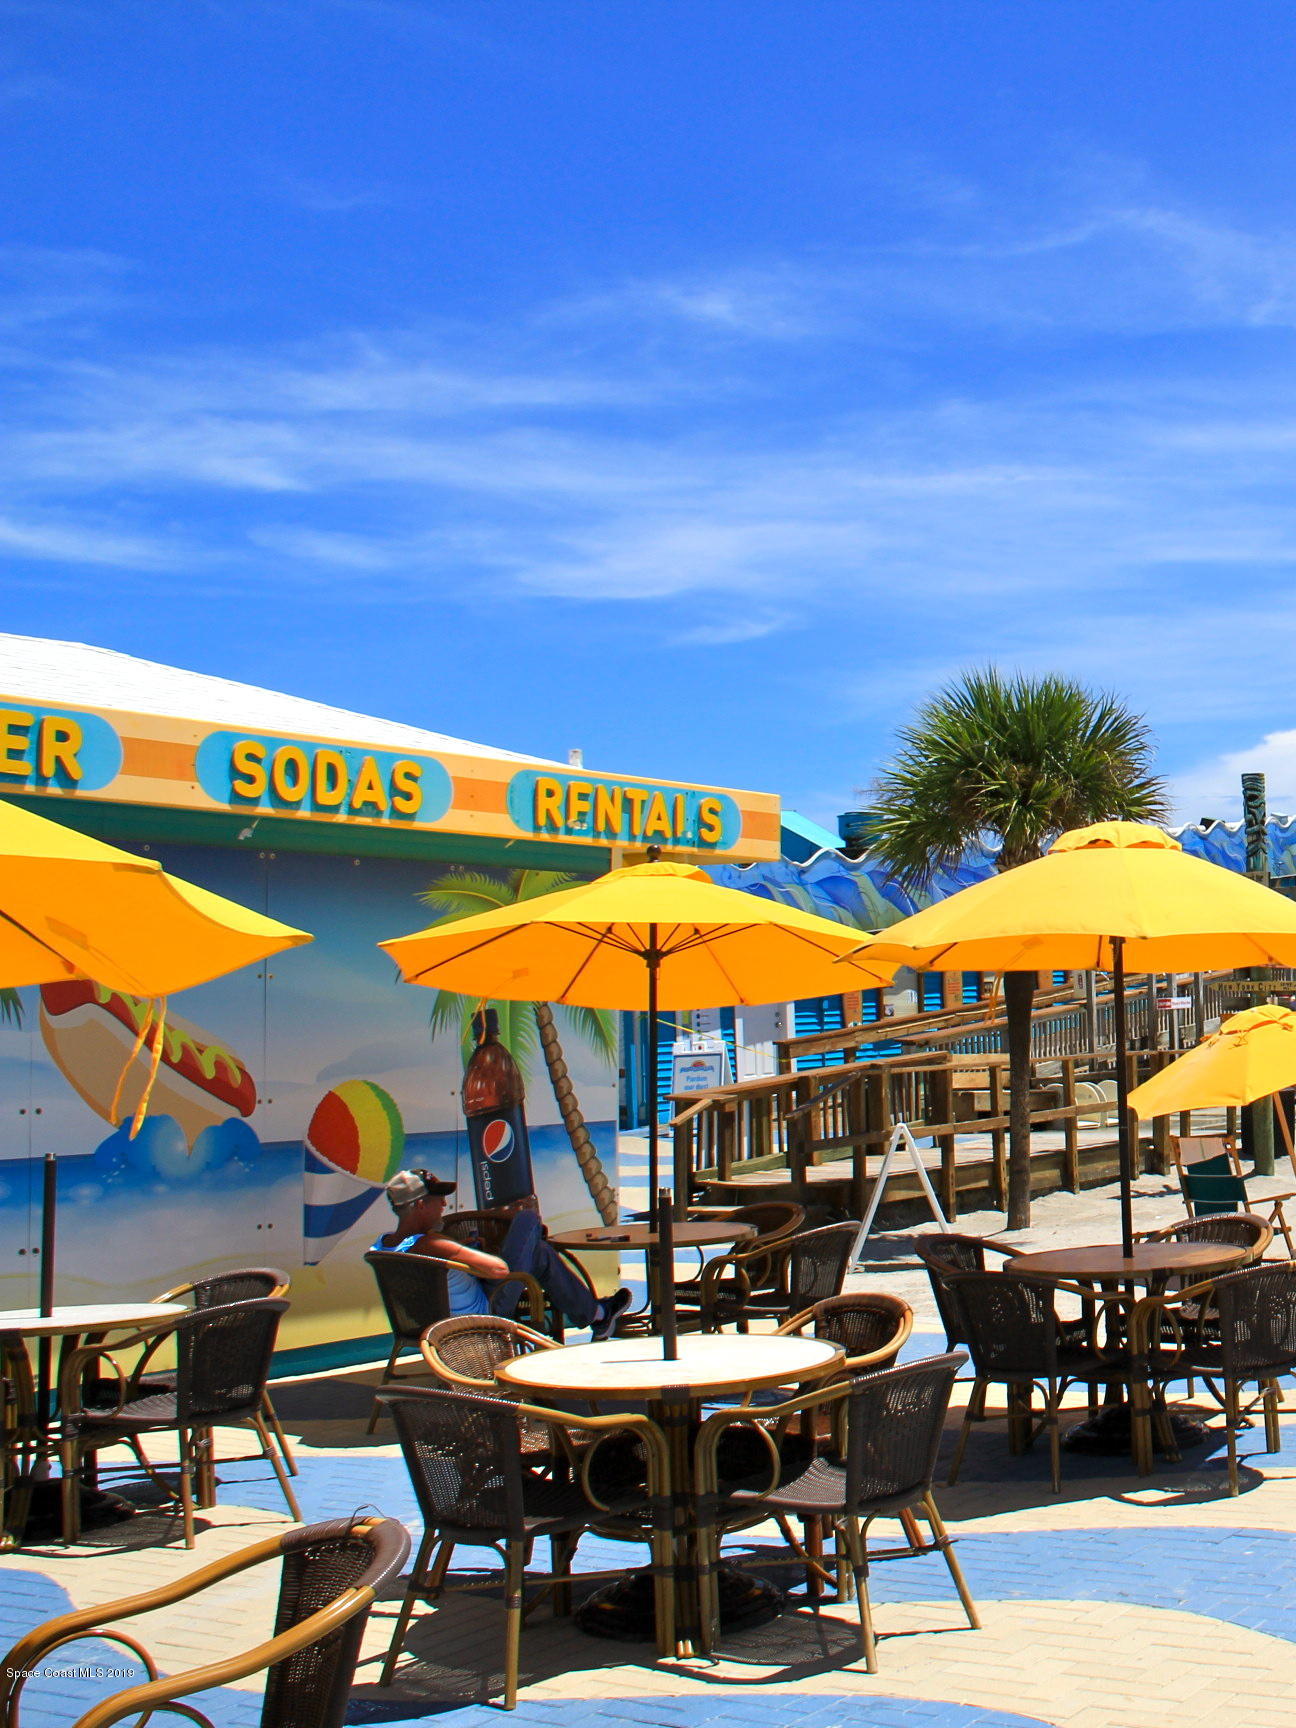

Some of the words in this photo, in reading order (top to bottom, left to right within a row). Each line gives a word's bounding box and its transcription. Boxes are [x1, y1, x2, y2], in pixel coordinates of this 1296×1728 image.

[0, 709, 84, 780] ER
[232, 740, 423, 814] SODAS
[534, 777, 723, 843] RENTALS
[1236, 983, 1255, 991] YORK
[1258, 982, 1276, 991] CITY
[480, 1160, 495, 1200] pepsi
